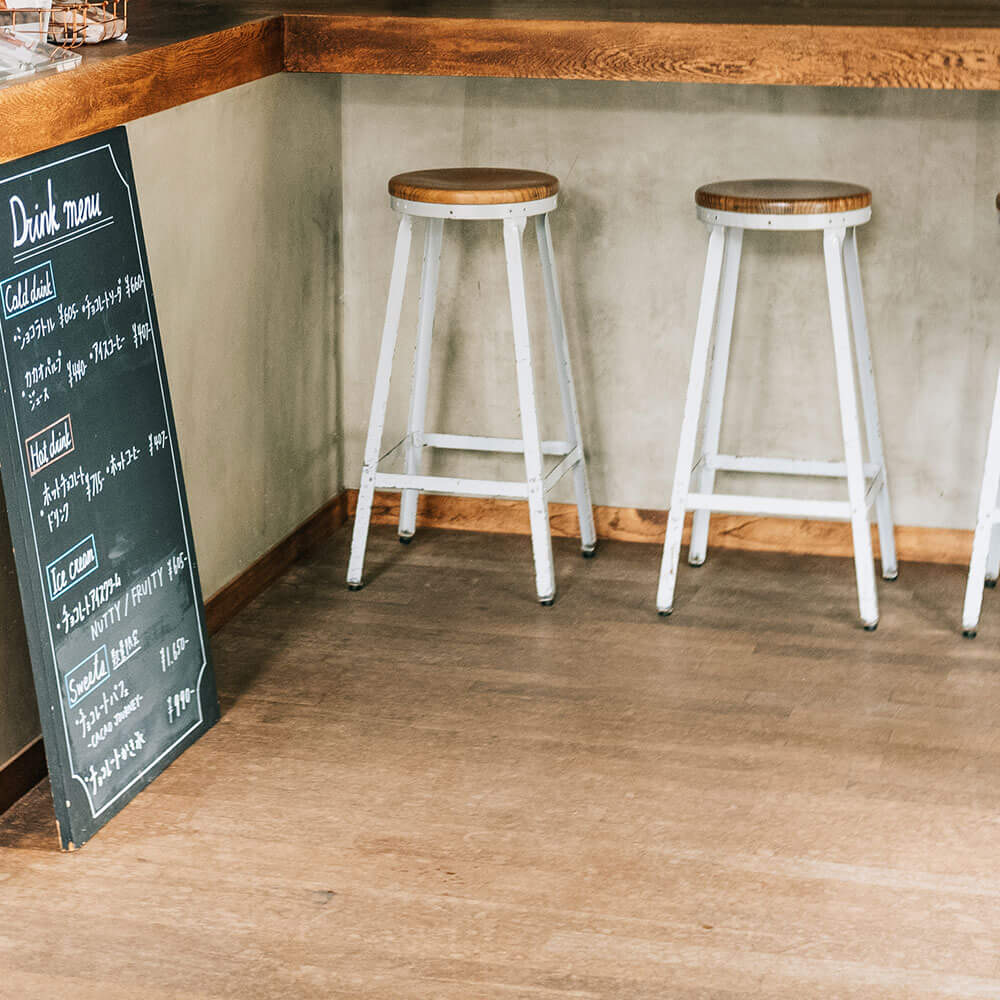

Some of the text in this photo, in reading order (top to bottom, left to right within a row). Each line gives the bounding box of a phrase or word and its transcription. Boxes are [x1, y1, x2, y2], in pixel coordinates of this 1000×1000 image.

[9, 178, 102, 248] Drink menu
[5, 270, 53, 312] Cold drink
[30, 421, 71, 470] Hot drink
[50, 548, 94, 594] Ice cream
[90, 601, 120, 640] NUTTY
[131, 567, 163, 607] FRUITY
[69, 654, 107, 703] Sweets
